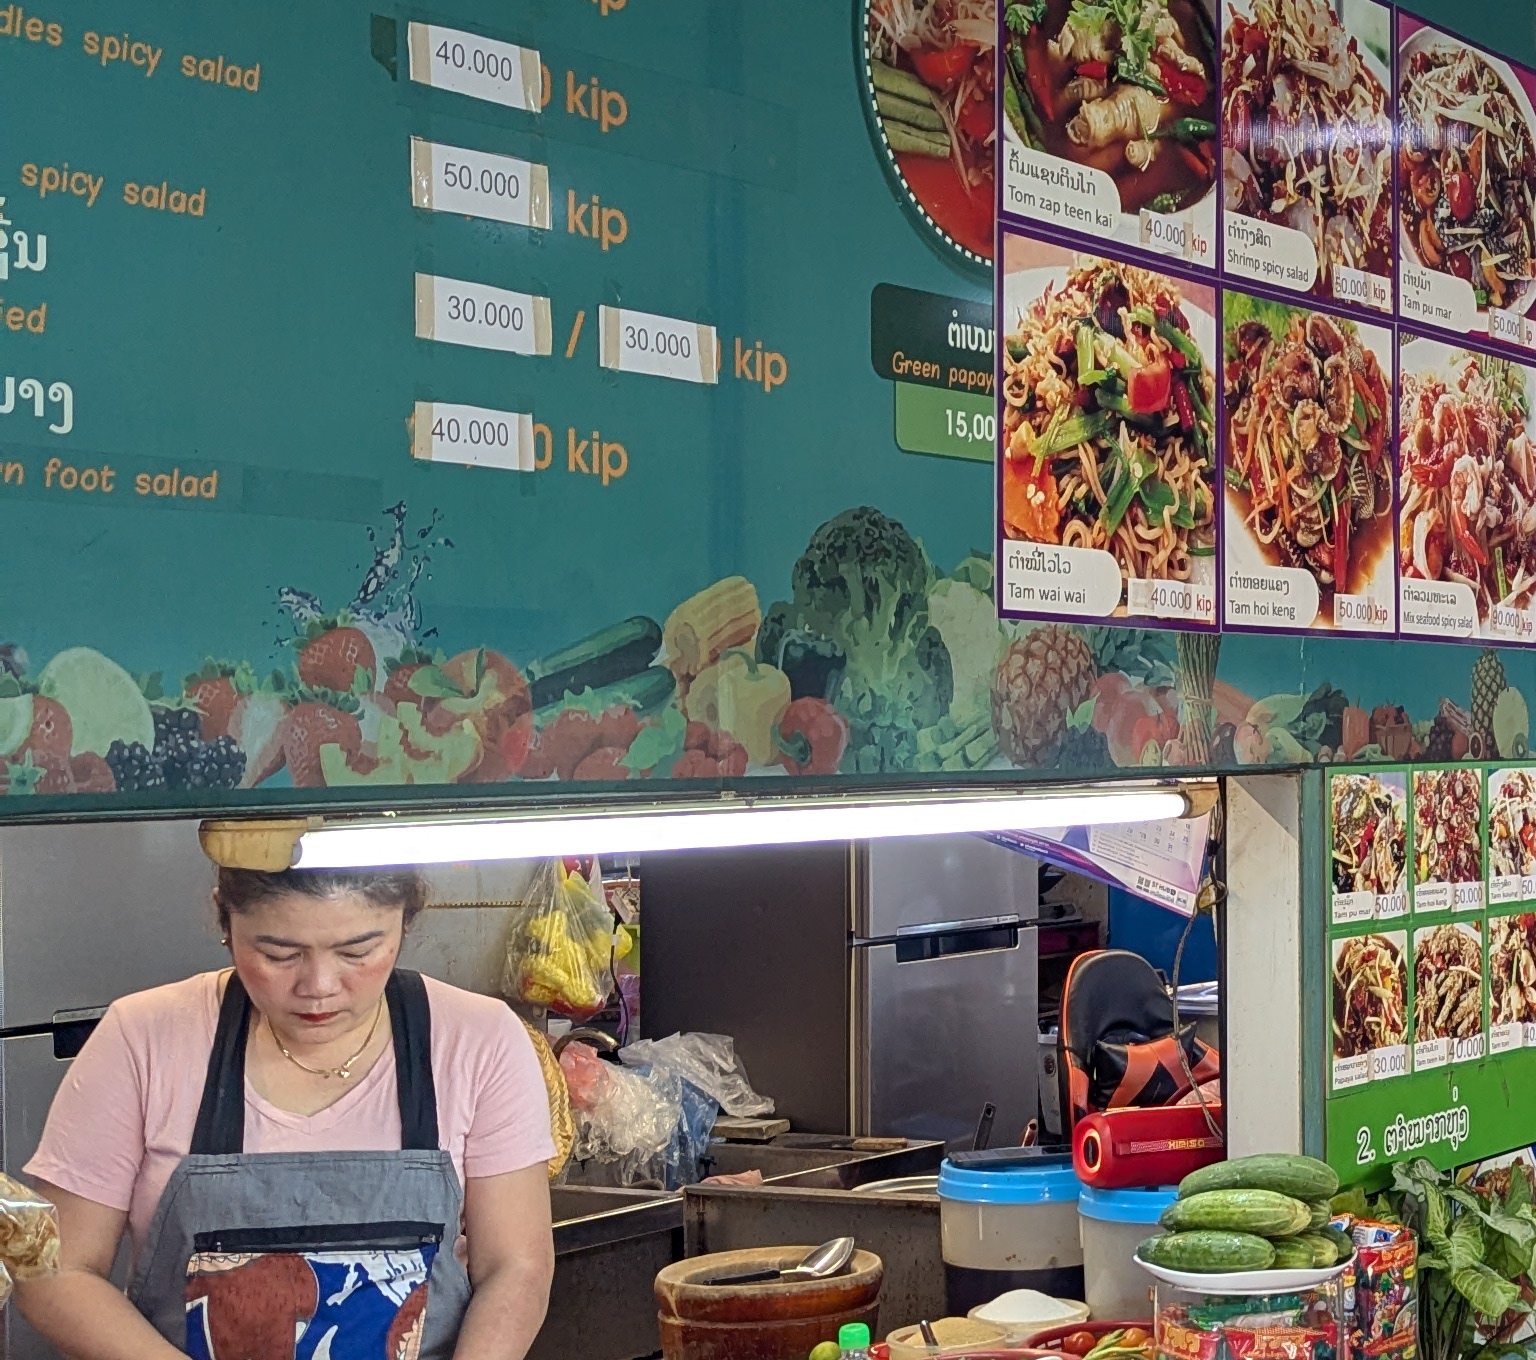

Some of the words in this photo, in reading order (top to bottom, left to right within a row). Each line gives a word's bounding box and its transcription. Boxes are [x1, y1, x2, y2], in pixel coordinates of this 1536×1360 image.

[84, 31, 162, 78] spicy
[182, 53, 261, 92] salad
[435, 40, 513, 82] 40.000
[566, 70, 628, 132] kip
[21, 163, 104, 208] spicy
[123, 181, 206, 217] salad
[443, 162, 520, 199] 50.000
[567, 189, 628, 251] kip
[1008, 185, 1036, 207] Tom
[1039, 195, 1061, 220] zap
[1064, 200, 1092, 223] teen
[1095, 209, 1113, 228] kai
[1145, 218, 1186, 247] 40.000
[1191, 232, 1207, 255] kip
[1227, 249, 1260, 274] Shrimp
[1262, 258, 1284, 279] spicy
[1286, 265, 1309, 283] salad
[1335, 276, 1368, 298] 50.000
[1372, 283, 1386, 302] kip
[1402, 294, 1420, 311] Tam
[1422, 301, 1434, 316] pu
[1435, 304, 1452, 320] mar
[447, 295, 524, 332] 30.000
[625, 325, 692, 358] 30.000
[734, 337, 788, 392] kip
[892, 351, 940, 380] Green
[948, 366, 994, 395] papay
[431, 417, 509, 447] 40.000
[567, 427, 628, 486] kip
[45, 457, 117, 493] foot
[135, 469, 218, 499] salad
[1008, 583, 1035, 600] Tam
[1038, 586, 1061, 602] wai
[1064, 587, 1086, 604] wai
[1150, 589, 1192, 611] 40.000
[1196, 594, 1212, 616] kip
[1229, 600, 1251, 616] Tam
[1253, 601, 1270, 616] hoi
[1272, 603, 1296, 620] keng
[1339, 600, 1372, 621] 50.000
[1375, 606, 1388, 625] kip
[1403, 611, 1414, 623] Mix
[1415, 612, 1440, 627] seafood
[1375, 895, 1407, 913] 50.000
[1454, 886, 1483, 904] 50.000
[1334, 910, 1347, 919] Tam
[1449, 1036, 1485, 1060] 40.000
[1373, 1054, 1406, 1074] 30.000
[1356, 1127, 1377, 1165] 2.
